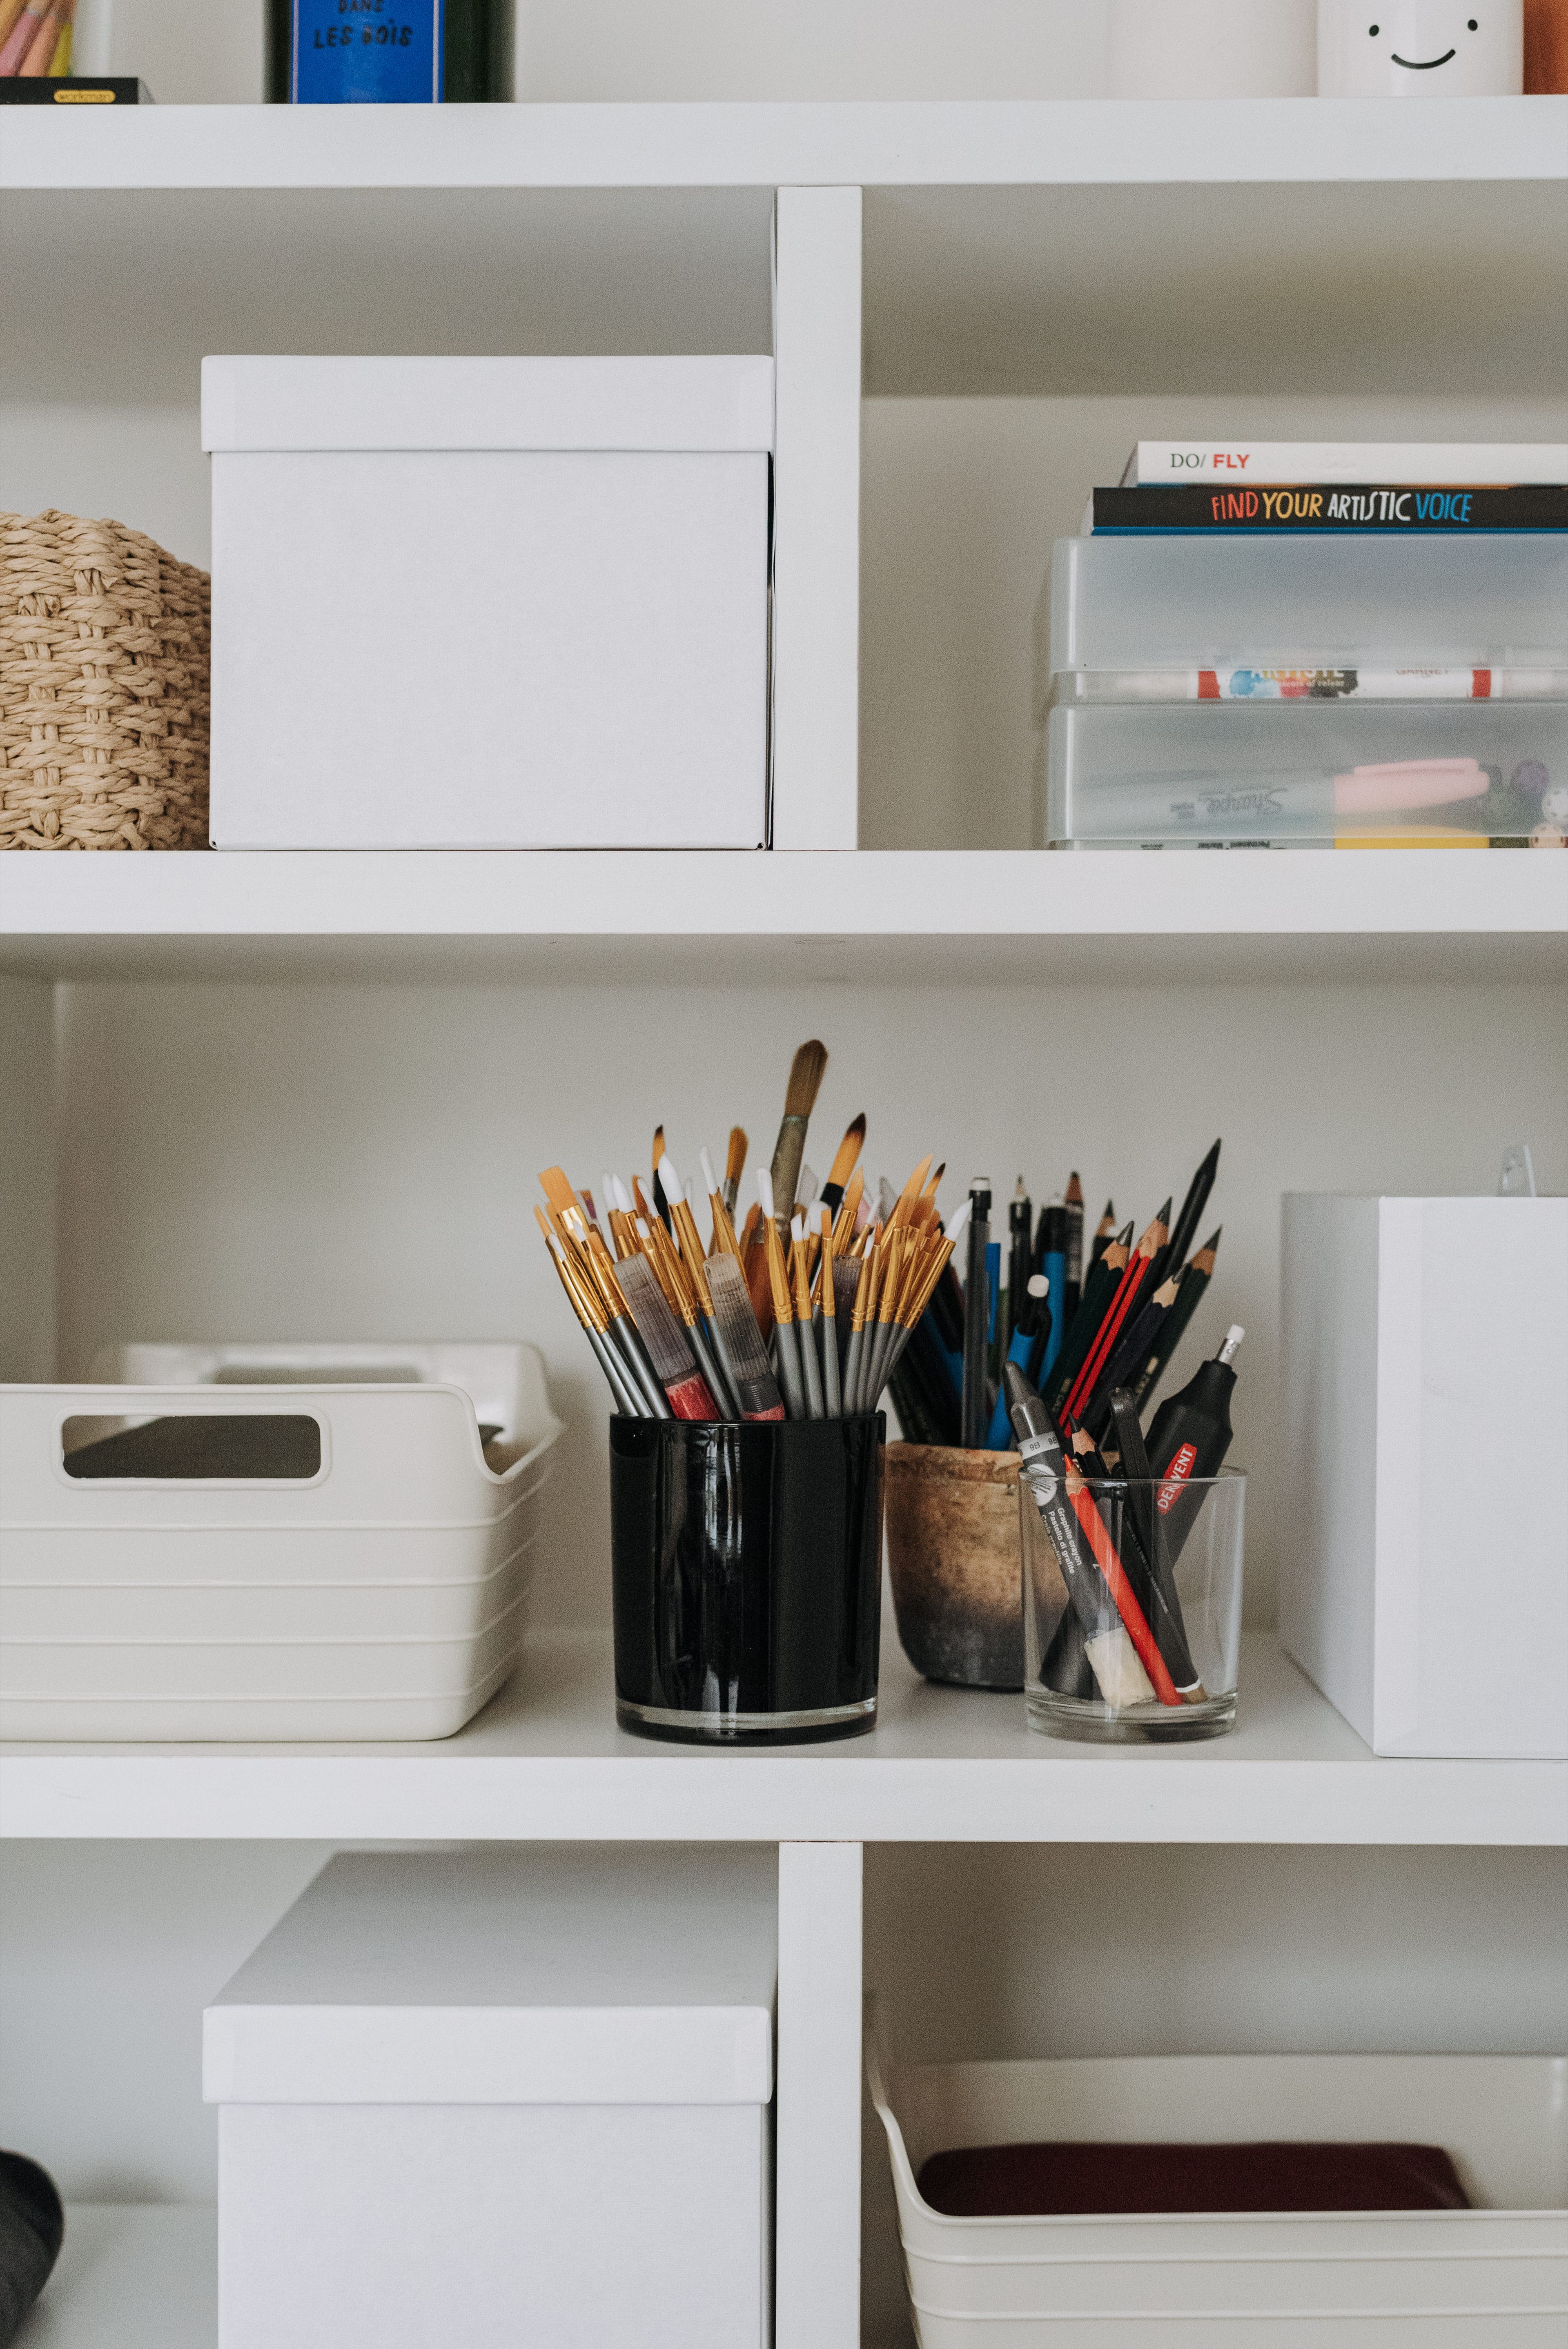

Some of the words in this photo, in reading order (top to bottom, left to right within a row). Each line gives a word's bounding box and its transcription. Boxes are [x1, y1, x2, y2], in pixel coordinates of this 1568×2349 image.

[314, 26, 353, 49] LES
[1213, 454, 1250, 468] FLY
[1212, 492, 1258, 520] FIND
[1262, 492, 1323, 519] YOUR
[1327, 491, 1412, 521] ARTISTIC
[1415, 493, 1473, 523] VOICE
[1029, 1442, 1040, 1451] 9B
[1049, 1511, 1062, 1540] Pastello
[1062, 1550, 1074, 1574] grafite
[1058, 1508, 1072, 1539] Graphite
[1069, 1540, 1082, 1565] crayon
